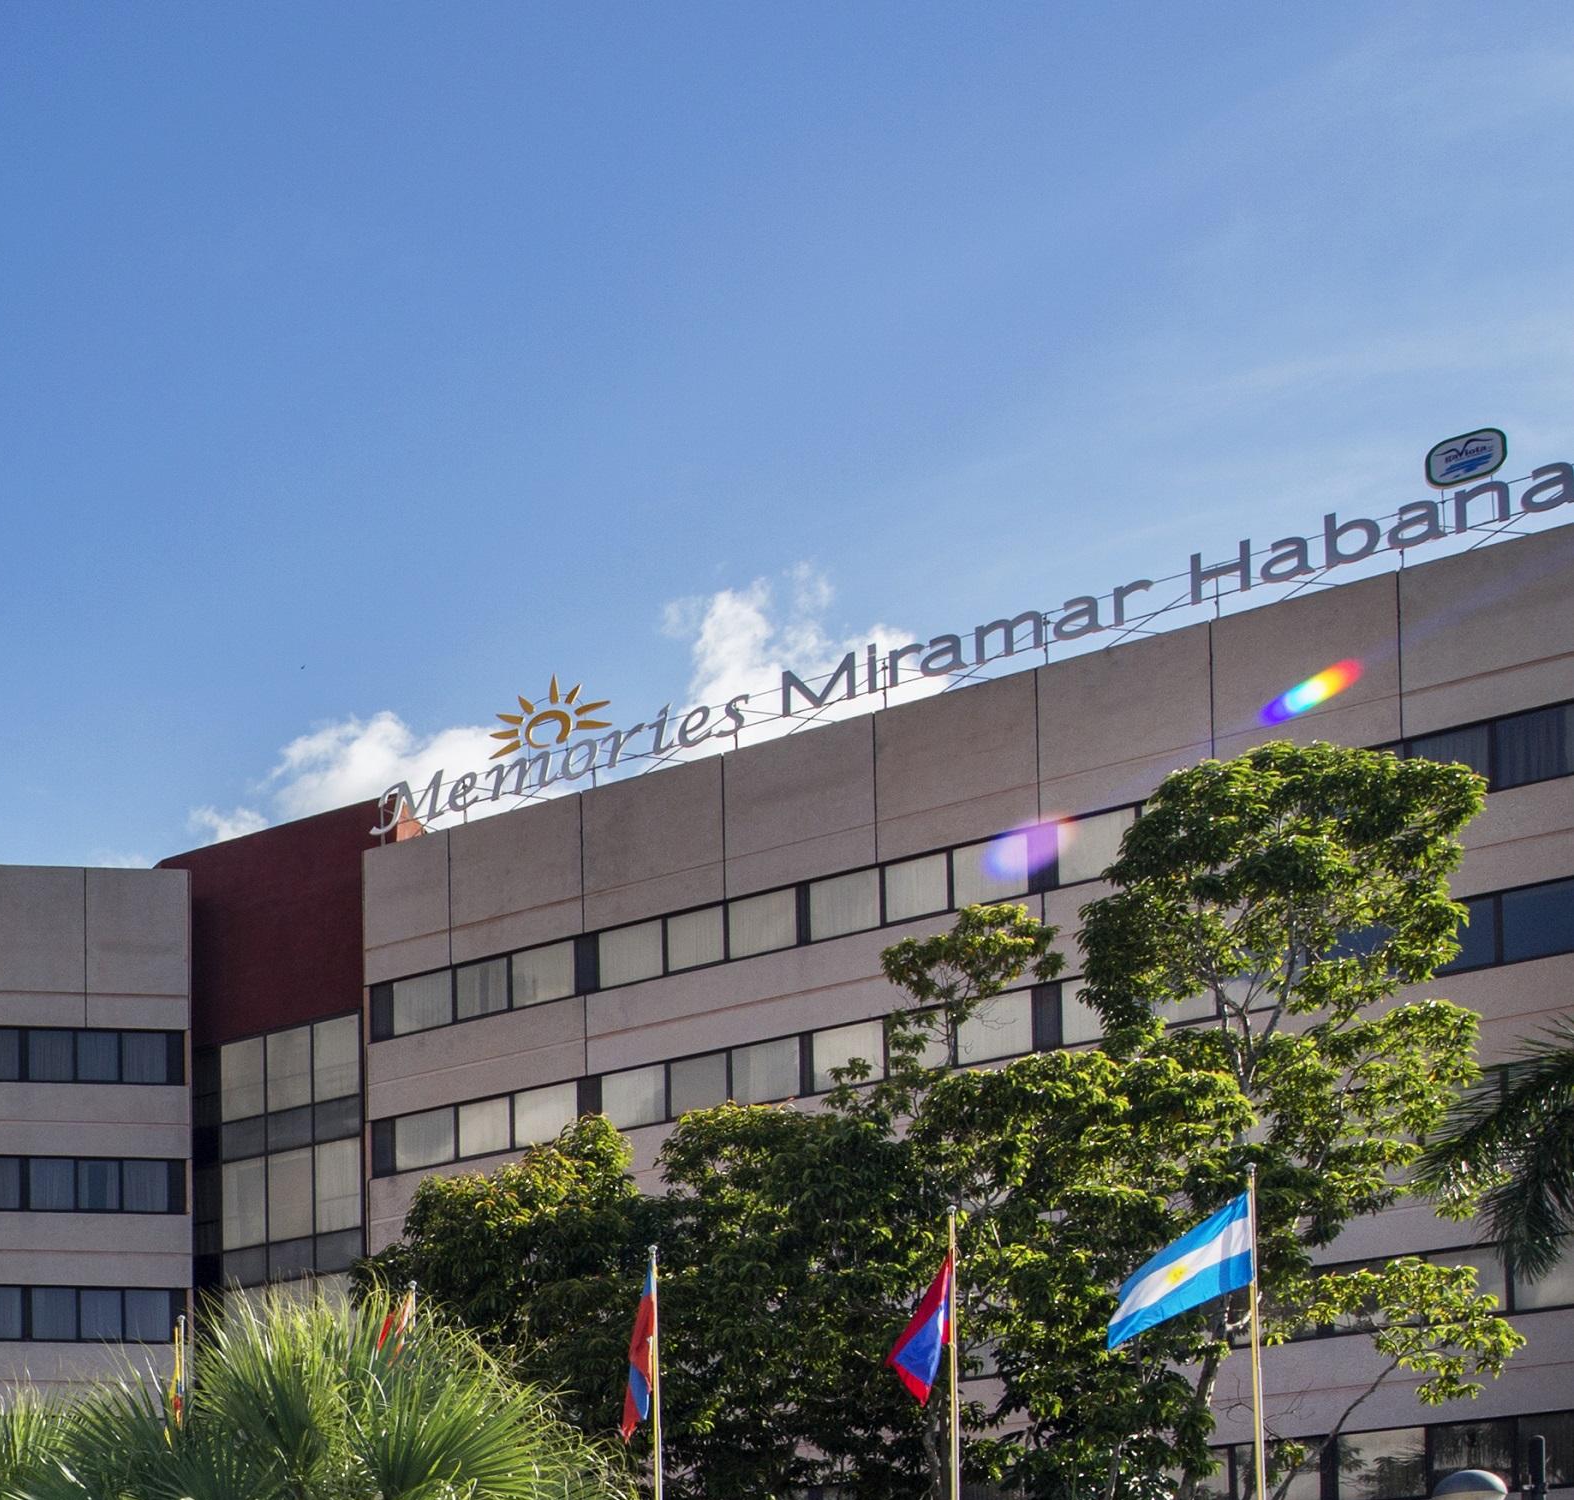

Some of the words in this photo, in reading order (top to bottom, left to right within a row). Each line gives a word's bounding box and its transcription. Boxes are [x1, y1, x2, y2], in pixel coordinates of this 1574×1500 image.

[369, 694, 750, 836] Memories
[782, 579, 1153, 718] Miramar
[1190, 462, 1574, 605] Habana
